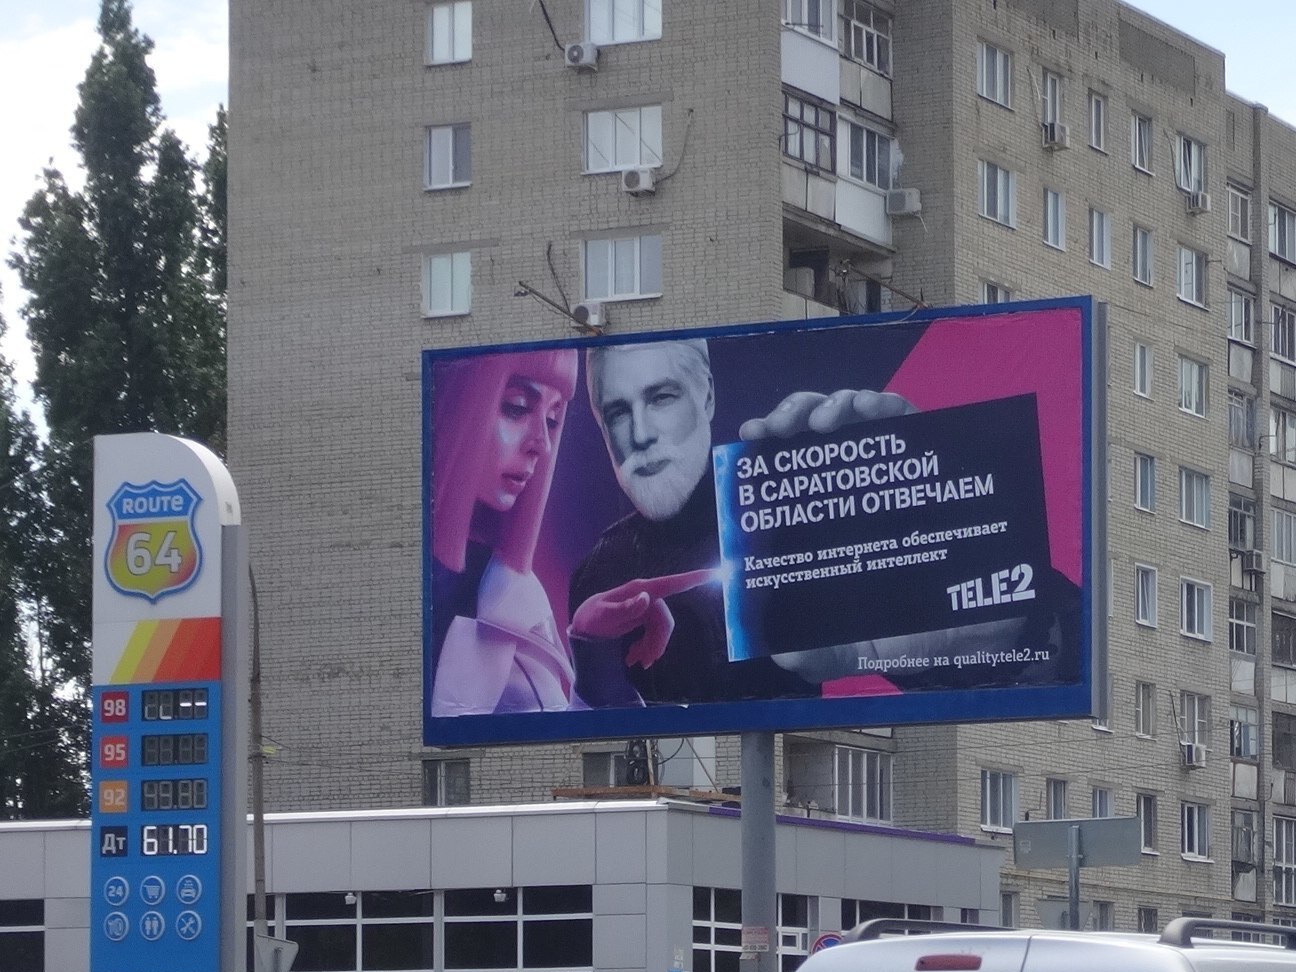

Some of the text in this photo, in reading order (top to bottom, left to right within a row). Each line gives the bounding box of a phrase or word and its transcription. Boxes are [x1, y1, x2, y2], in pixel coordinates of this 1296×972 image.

[737, 434, 907, 479] ЗА СКОРОСТЬ
[738, 450, 940, 507] В САРАТОВСКОЙ
[740, 473, 995, 533] ОБЛАСТИ ОТВЕЧАЕМ
[125, 530, 183, 577] 64
[743, 521, 1008, 572] Качество интернета обеспечивает
[745, 548, 948, 590] искусственный интеллект
[946, 563, 1036, 611] TELE2
[857, 648, 1050, 672] Подробнее на quality.tele2.ru
[103, 699, 126, 717] 98
[104, 744, 126, 761] 95
[103, 788, 126, 806] 92
[142, 824, 208, 856] 61.70
